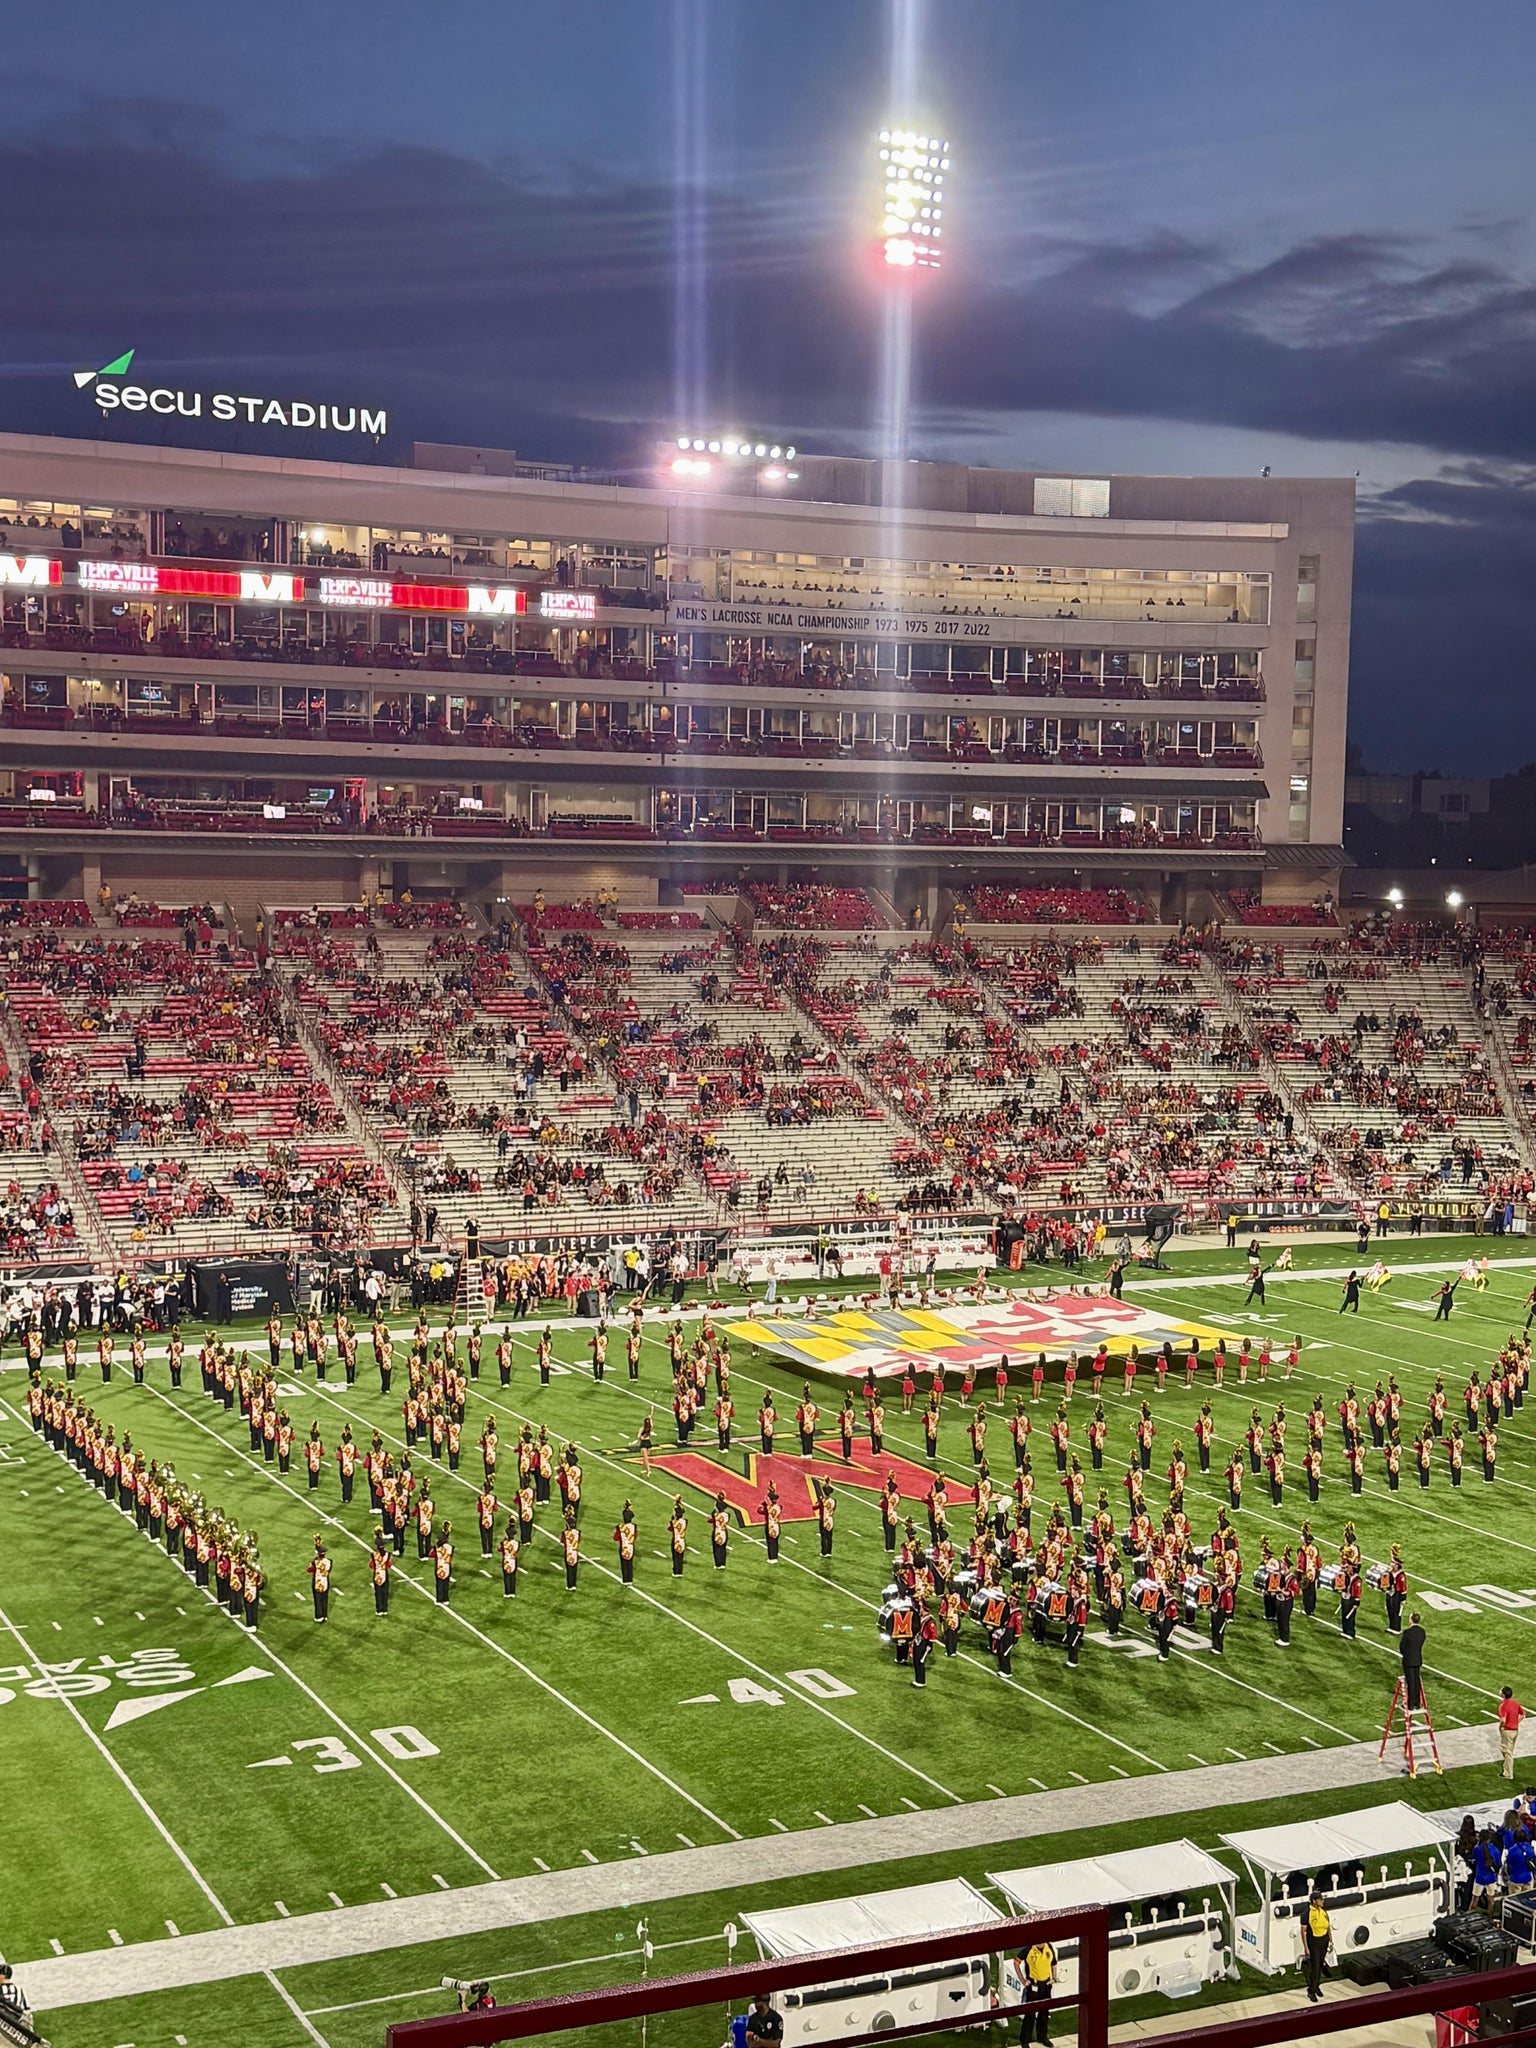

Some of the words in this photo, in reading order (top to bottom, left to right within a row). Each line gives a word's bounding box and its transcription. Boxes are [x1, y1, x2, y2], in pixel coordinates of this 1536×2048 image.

[212, 393, 387, 435] STADIUM
[78, 561, 158, 582] TERPSVILLE
[240, 571, 294, 601] M
[320, 577, 392, 597] TERPSVILLE
[468, 587, 516, 614] M
[676, 606, 707, 621] MEN'S
[712, 609, 762, 625] LACROSSE
[767, 612, 793, 627] NCAA
[798, 614, 870, 630] CHAMPIONSHIP
[875, 618, 899, 632] 1973
[905, 620, 928, 633] 1975
[934, 621, 959, 635] 2017
[964, 623, 990, 636] 2022
[1123, 1207, 1145, 1219] SEE
[1248, 1203, 1273, 1215] OUR
[1285, 1202, 1320, 1214] TEAM
[508, 1239, 537, 1254] FOR
[1048, 1593, 1068, 1616] M
[1140, 1588, 1160, 1613] M
[1197, 1584, 1212, 1606] M
[893, 1611, 913, 1639] M
[983, 1599, 1005, 1627] M
